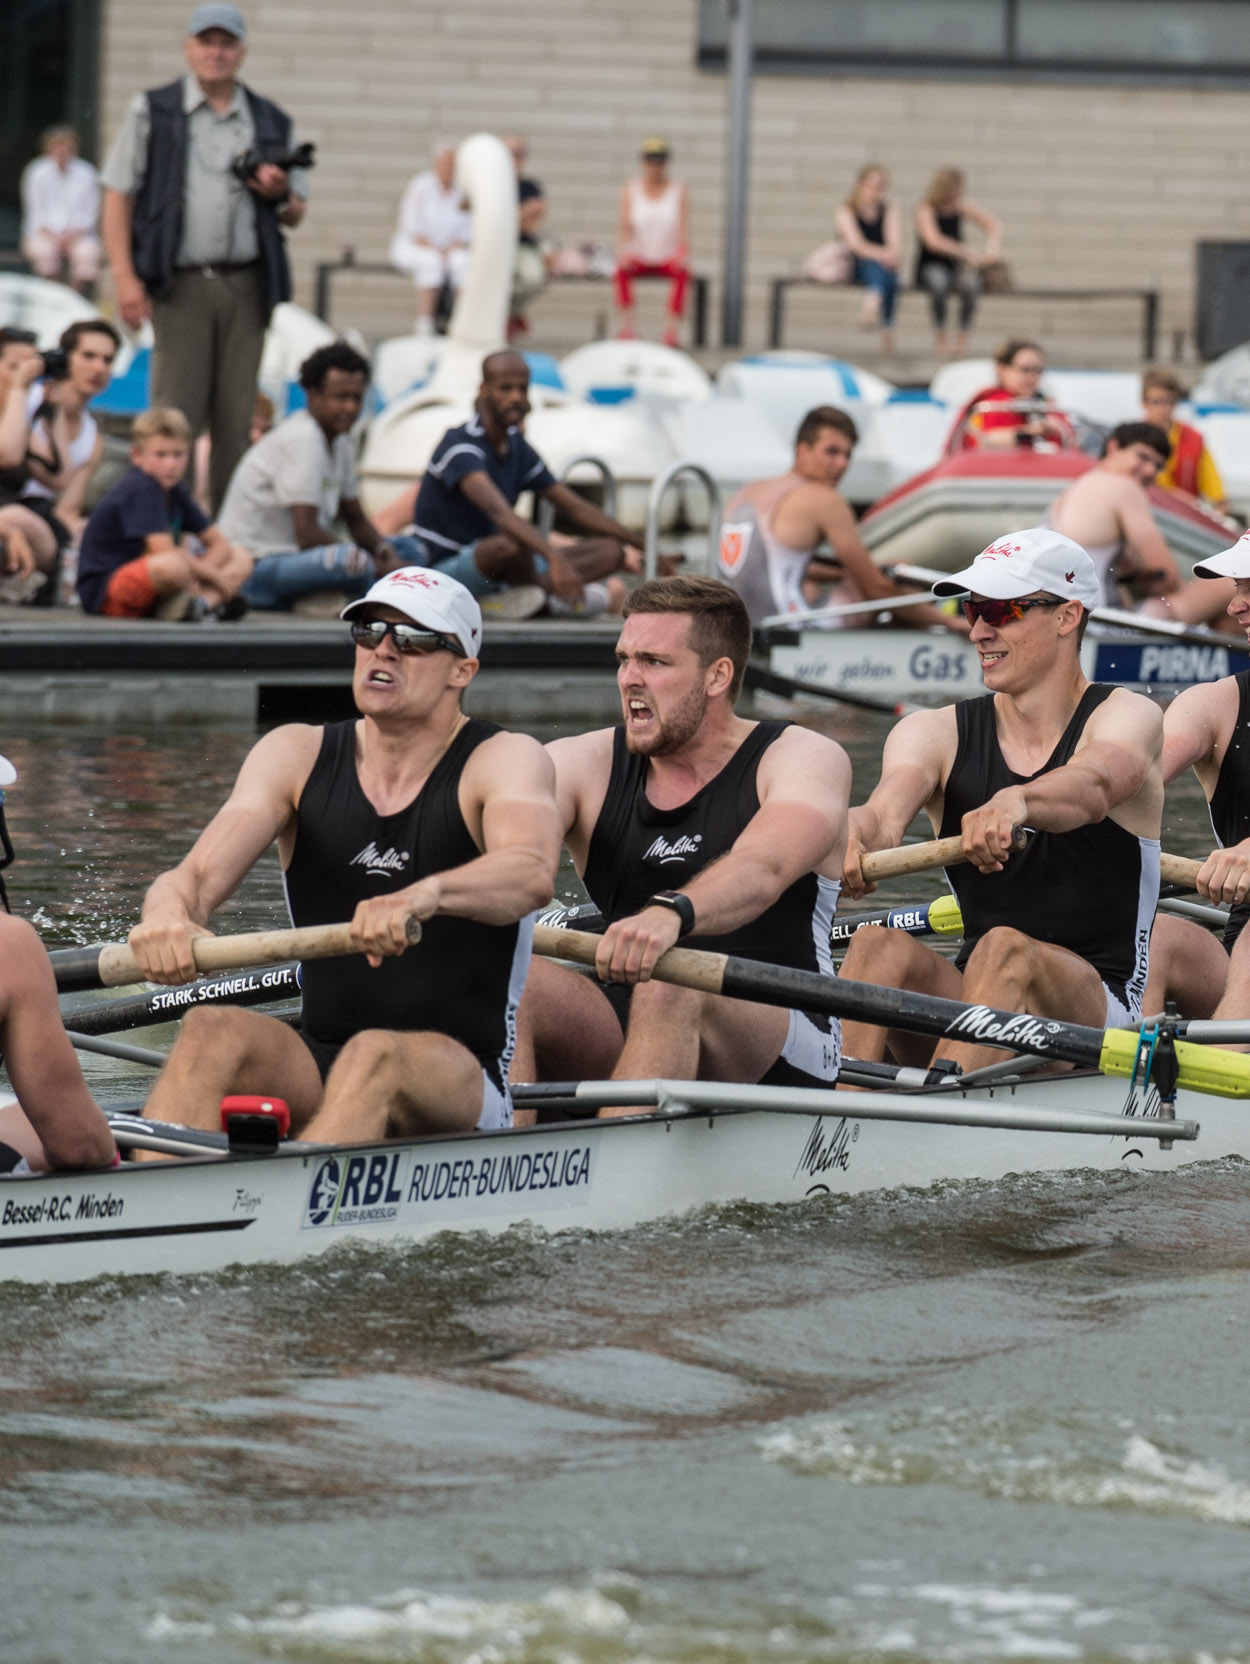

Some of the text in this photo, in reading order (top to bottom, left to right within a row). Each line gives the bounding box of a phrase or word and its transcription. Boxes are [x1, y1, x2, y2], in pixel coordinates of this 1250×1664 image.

[1139, 646, 1230, 682] PIRNA
[893, 911, 926, 929] RBL
[151, 969, 292, 1011] STARK. SCHNELL. GUT.
[340, 1154, 402, 1208] RBL
[407, 1148, 590, 1202] RUDER-BUNDESLIGA
[2, 1193, 124, 1225] Bessel-R.C. Minden
